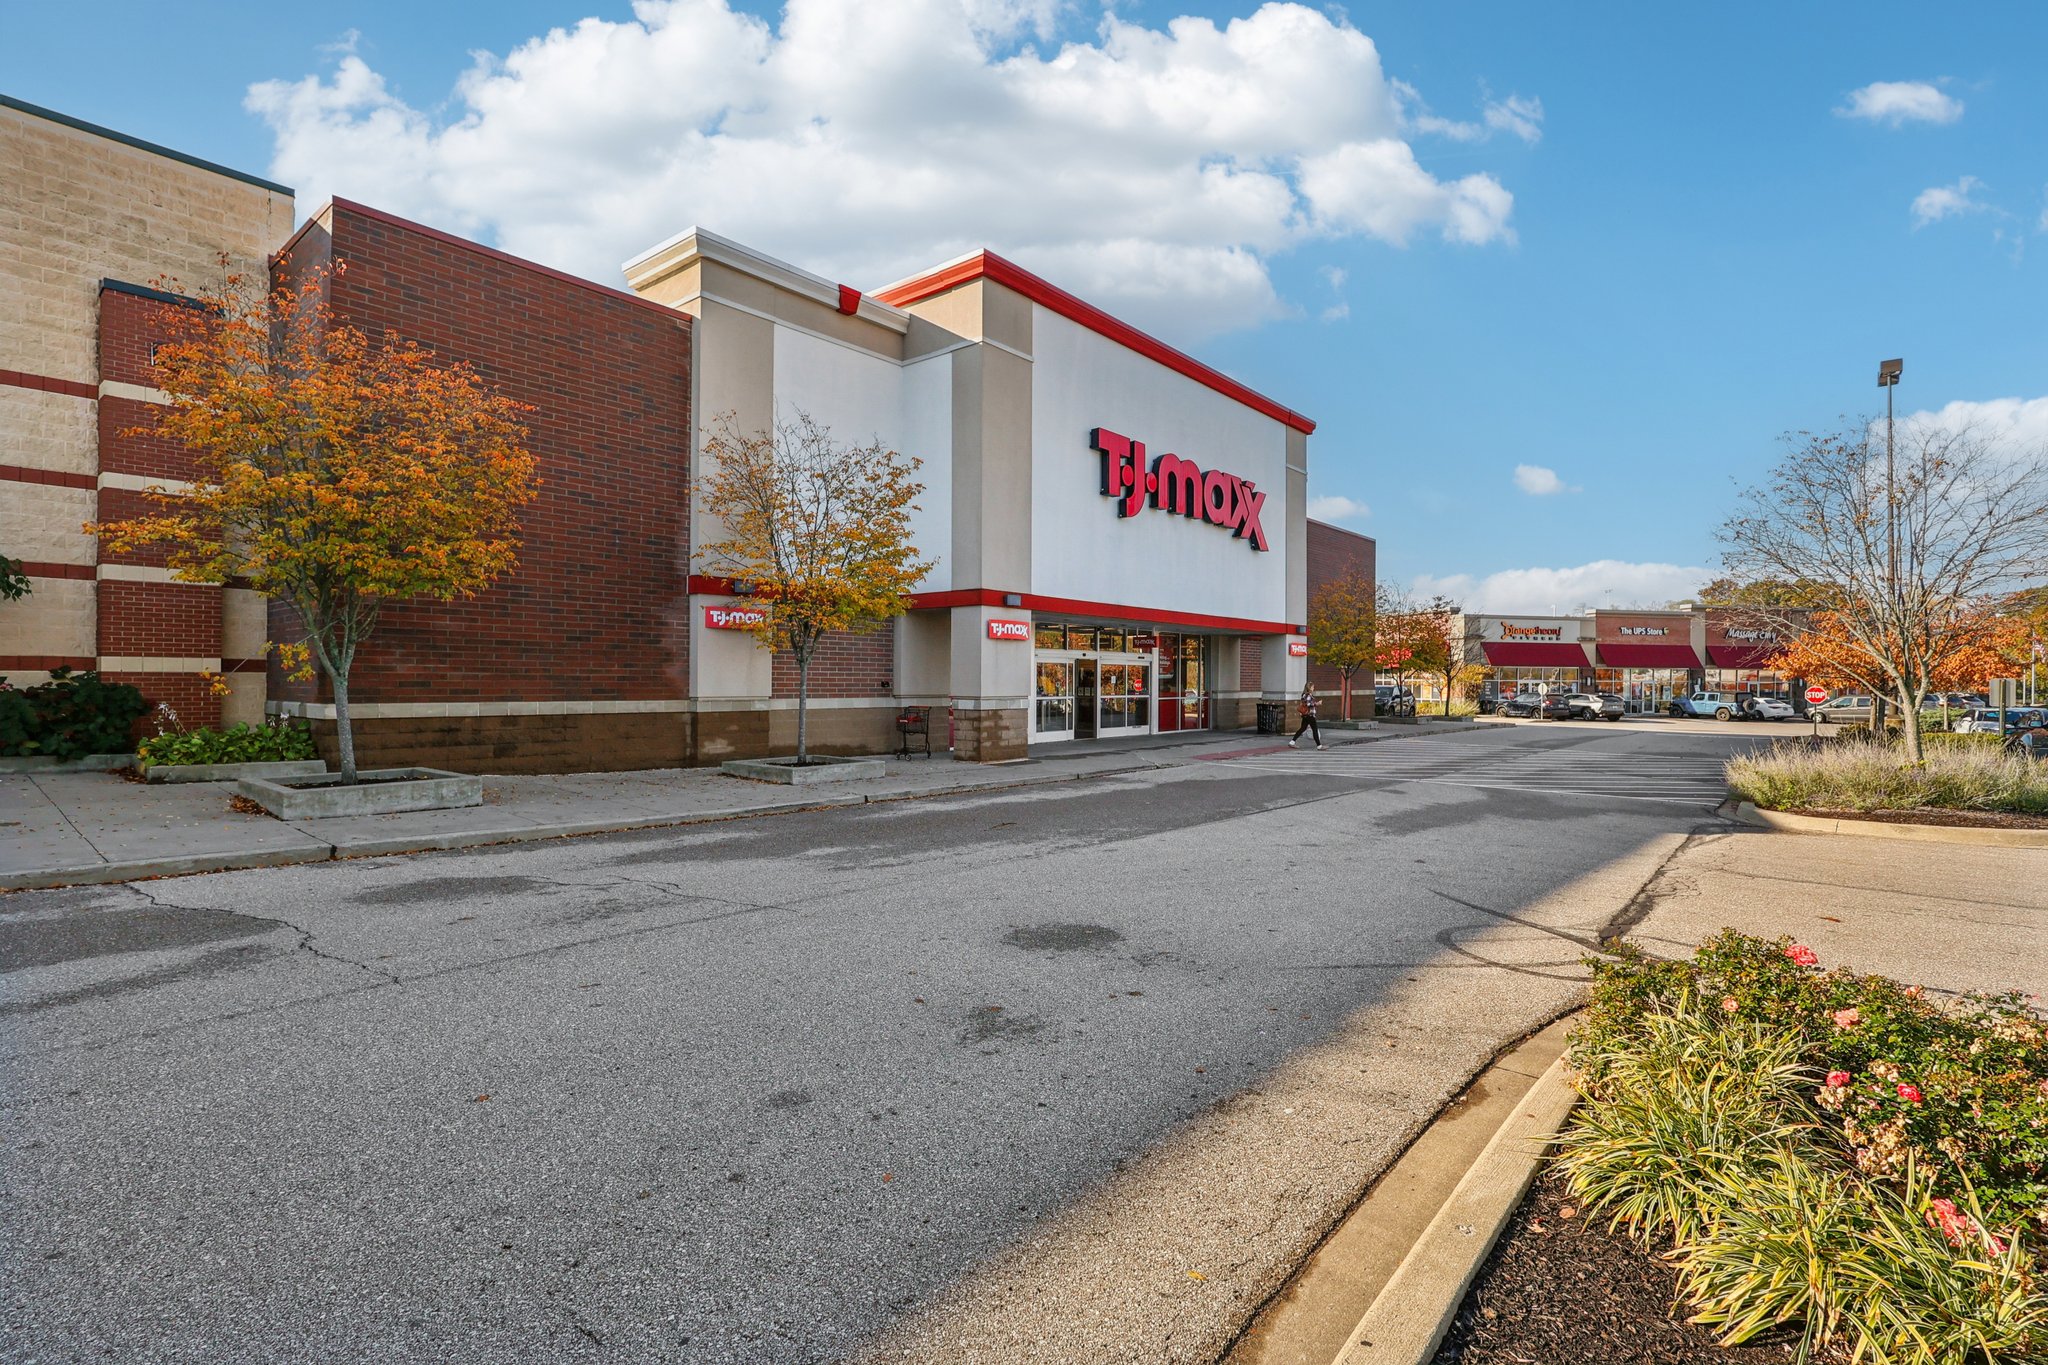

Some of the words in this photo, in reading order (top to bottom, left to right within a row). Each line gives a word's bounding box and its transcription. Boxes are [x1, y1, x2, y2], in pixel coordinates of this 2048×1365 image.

[1620, 626, 1633, 635] The
[1633, 627, 1646, 636] UPS
[1646, 627, 1663, 636] Store
[1725, 628, 1758, 642] Massage
[1806, 691, 1825, 699] STOP
